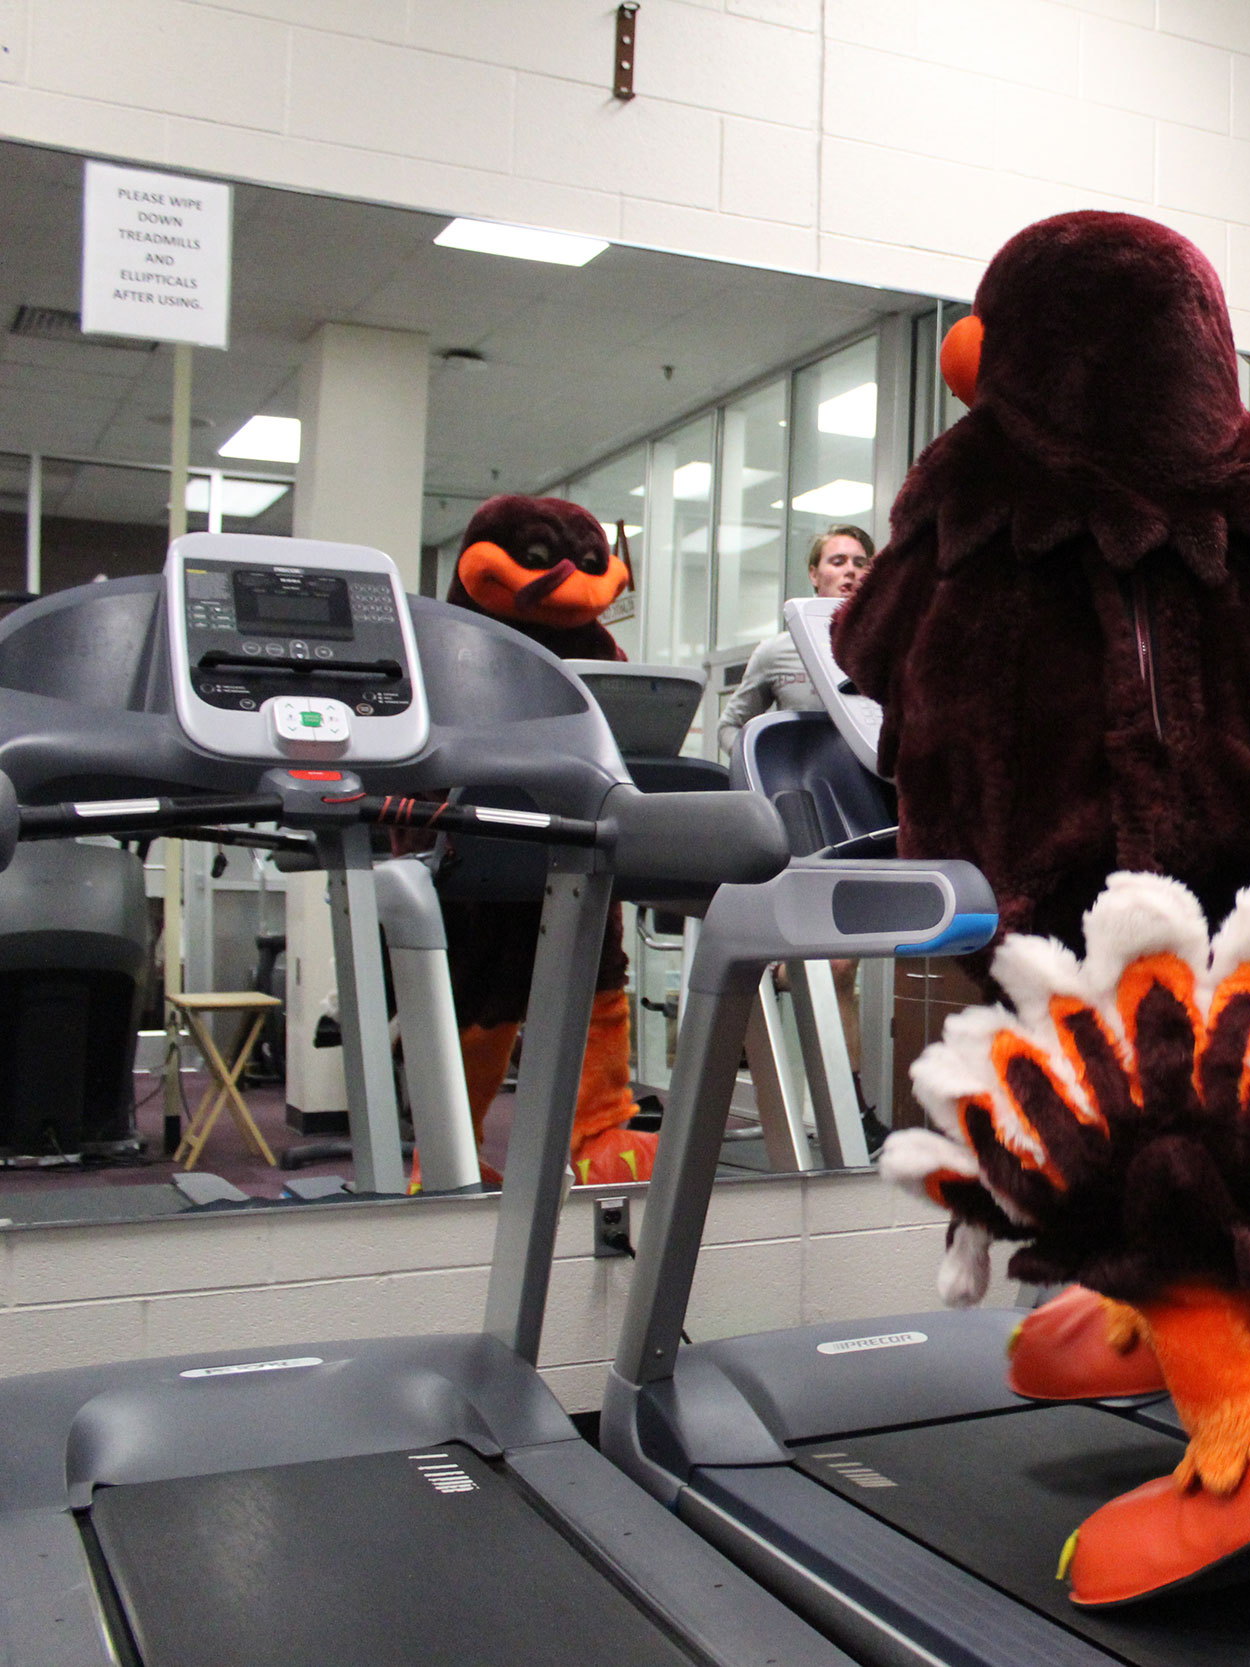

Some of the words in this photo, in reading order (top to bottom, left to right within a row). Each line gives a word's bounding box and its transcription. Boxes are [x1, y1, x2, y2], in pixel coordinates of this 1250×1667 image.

[118, 188, 165, 205] PLEASE
[169, 196, 203, 211] WIPE
[138, 211, 183, 227] DOWN
[118, 228, 201, 250] TREADMILLS
[145, 253, 175, 267] AND
[119, 269, 198, 289] ELLIPTICALS
[112, 288, 154, 304] AFTER
[158, 295, 204, 310] USING.
[845, 1334, 912, 1349] PRECOR
